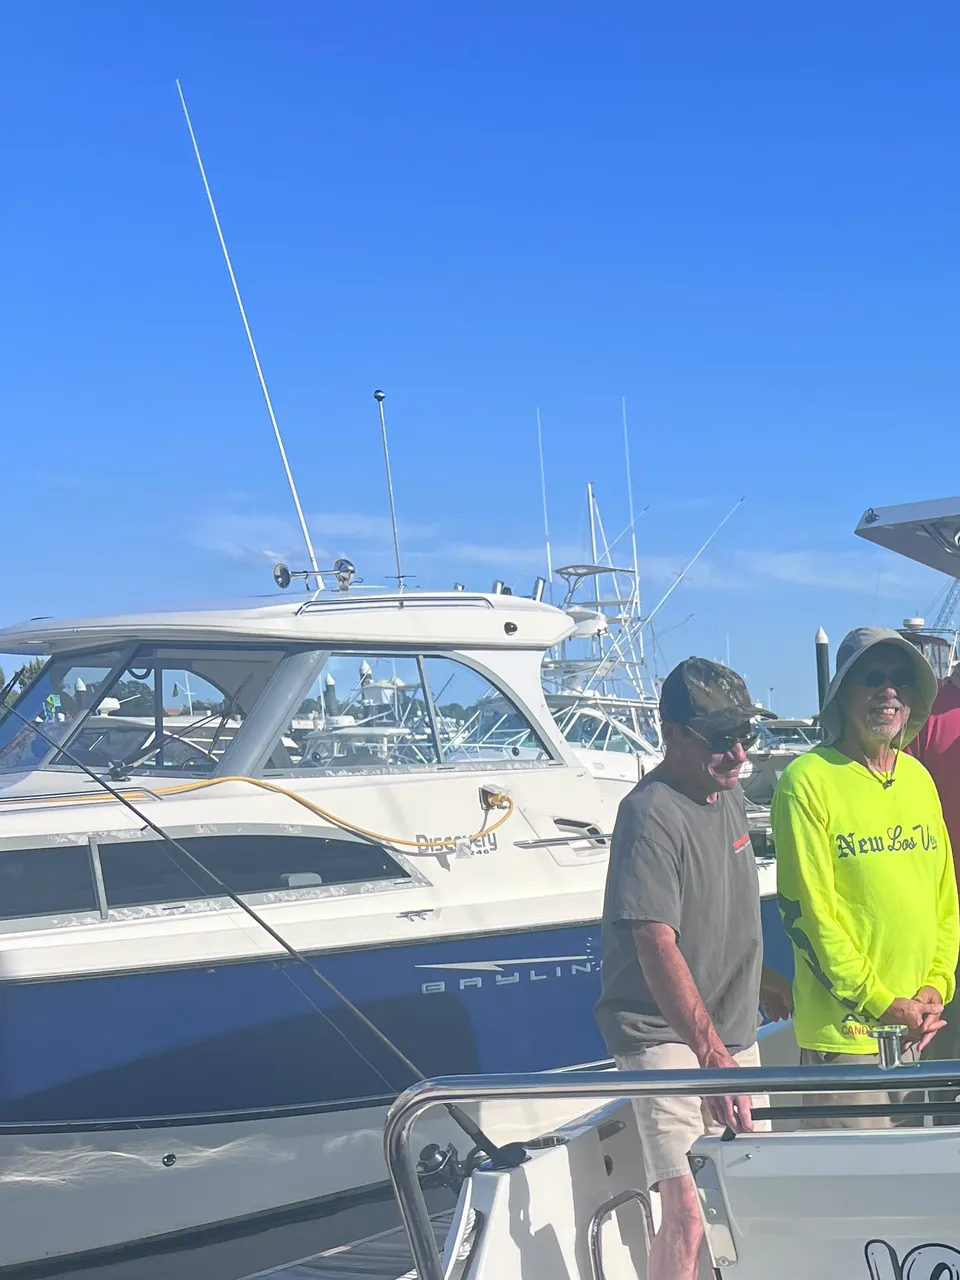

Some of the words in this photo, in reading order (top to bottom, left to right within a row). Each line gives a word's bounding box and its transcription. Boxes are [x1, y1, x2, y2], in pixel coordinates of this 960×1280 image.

[836, 832, 884, 858] New
[887, 825, 917, 852] Los
[421, 960, 603, 994] BAYLIN
[842, 1024, 873, 1037] CAND
